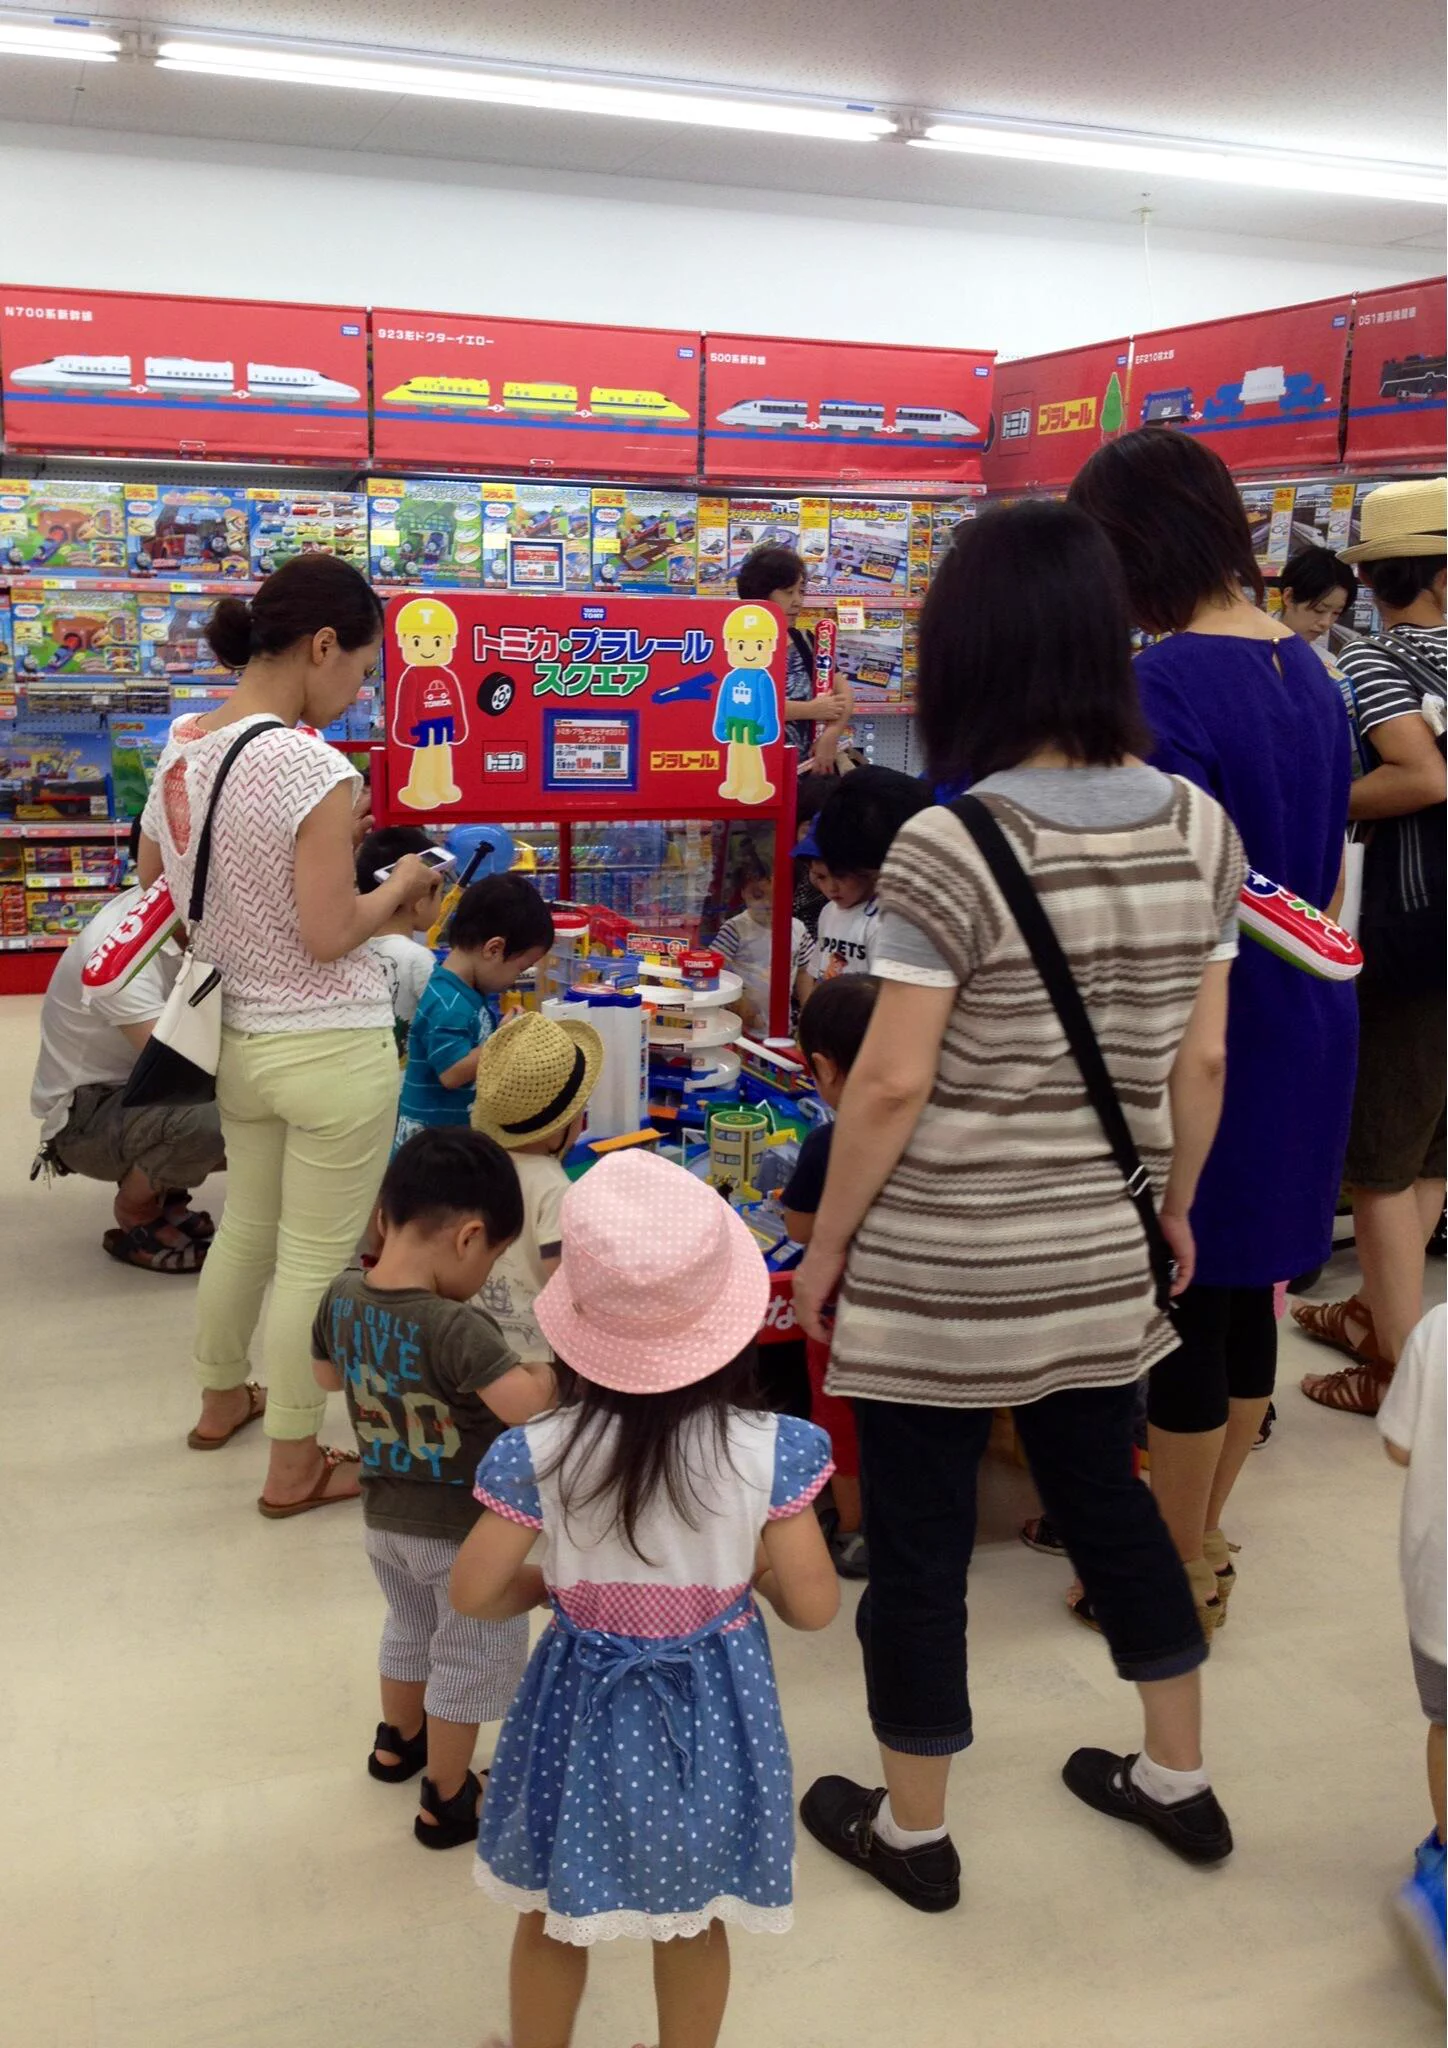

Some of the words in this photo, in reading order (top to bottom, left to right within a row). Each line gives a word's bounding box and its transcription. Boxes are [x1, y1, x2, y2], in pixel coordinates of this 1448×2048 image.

[1039, 402, 1094, 433] プラレール
[474, 626, 714, 664] トミカ・プラレール
[533, 663, 649, 696] スクエア
[485, 751, 525, 772] トミカ
[652, 753, 717, 769] プラレール
[684, 960, 714, 968] TOMICA
[365, 1305, 419, 1341] ONLY
[332, 1317, 421, 1381] LIVE
[363, 1437, 444, 1478] JOY
